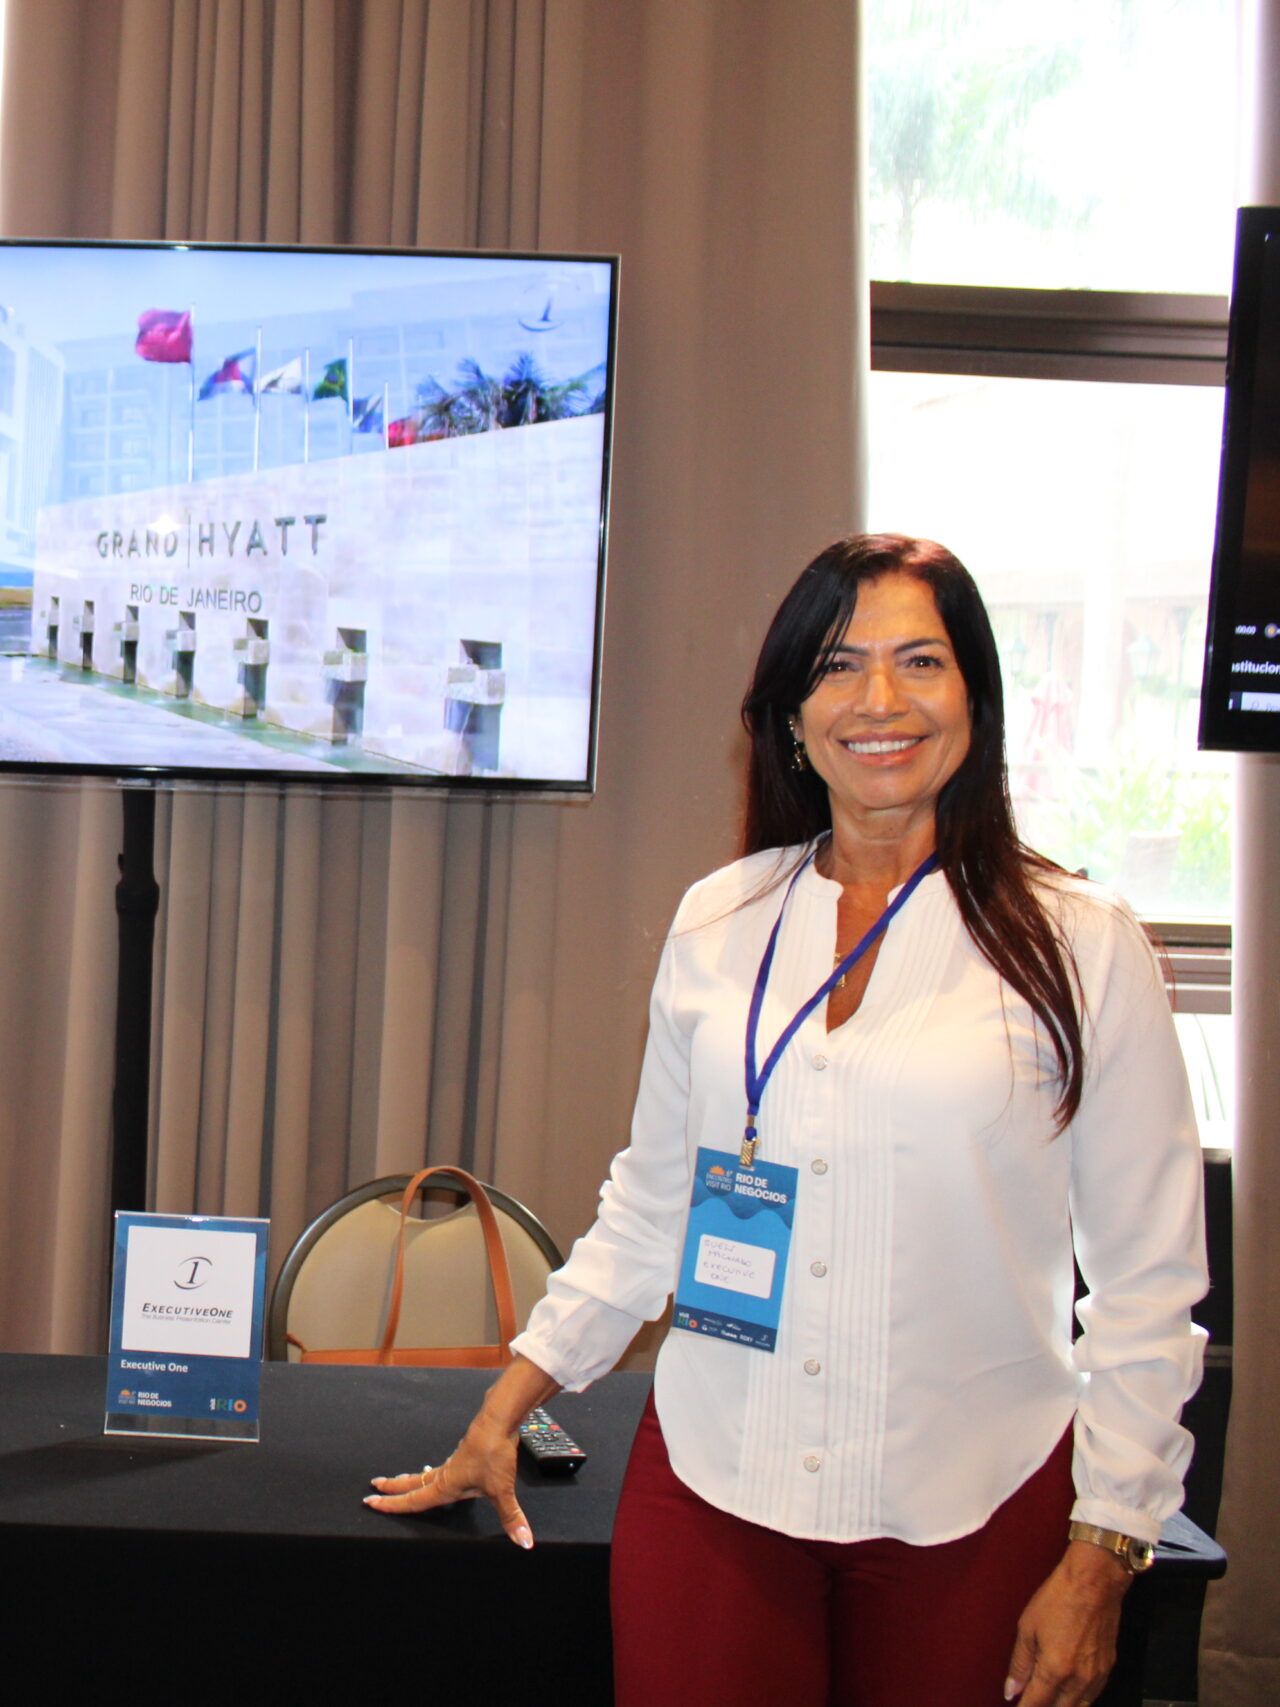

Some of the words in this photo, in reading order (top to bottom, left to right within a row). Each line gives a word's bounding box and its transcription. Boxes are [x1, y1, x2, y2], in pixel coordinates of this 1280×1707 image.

[96, 528, 179, 558] GRAND
[197, 513, 328, 557] HYATT
[130, 583, 153, 604] RIO
[159, 586, 179, 606] DE
[186, 588, 263, 614] JANEIRO
[735, 1172, 754, 1185] RIO
[754, 1176, 769, 1189] DE
[734, 1183, 788, 1204] NEGOCIOS
[120, 1359, 166, 1371] Executive
[168, 1362, 189, 1373] One
[137, 1391, 149, 1399] RIO
[150, 1392, 160, 1400] DE
[137, 1399, 172, 1408] NEGOCIOS
